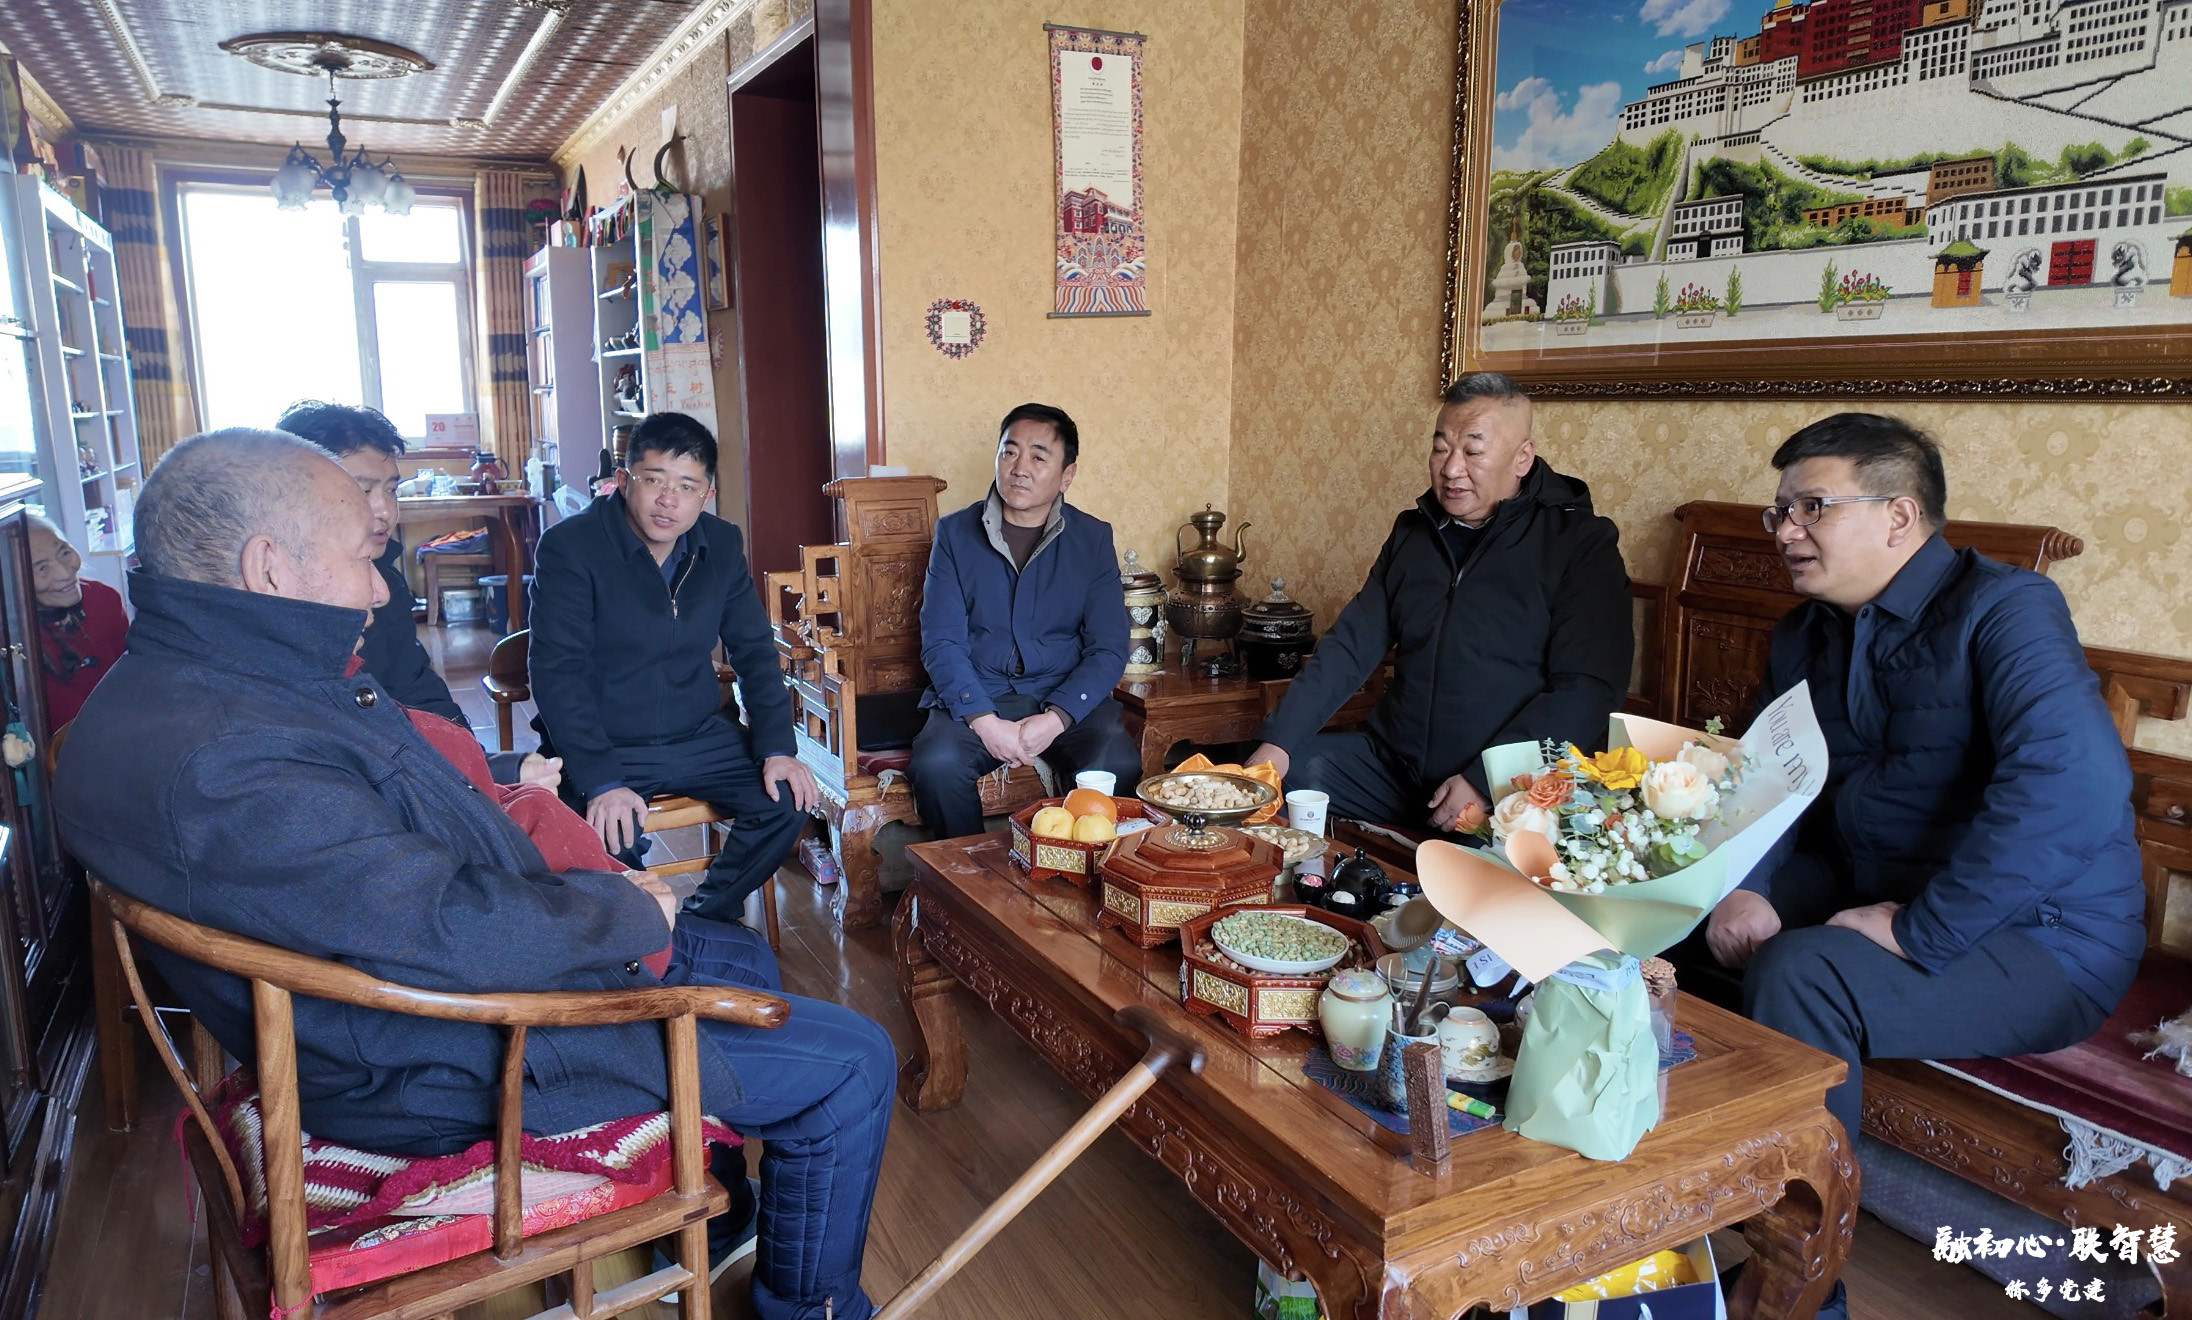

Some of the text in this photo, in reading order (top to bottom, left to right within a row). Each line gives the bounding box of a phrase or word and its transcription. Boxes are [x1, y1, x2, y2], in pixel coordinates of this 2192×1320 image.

[1768, 695, 1794, 733] You
[1771, 728, 1795, 757] are
[1783, 753, 1809, 793] my
